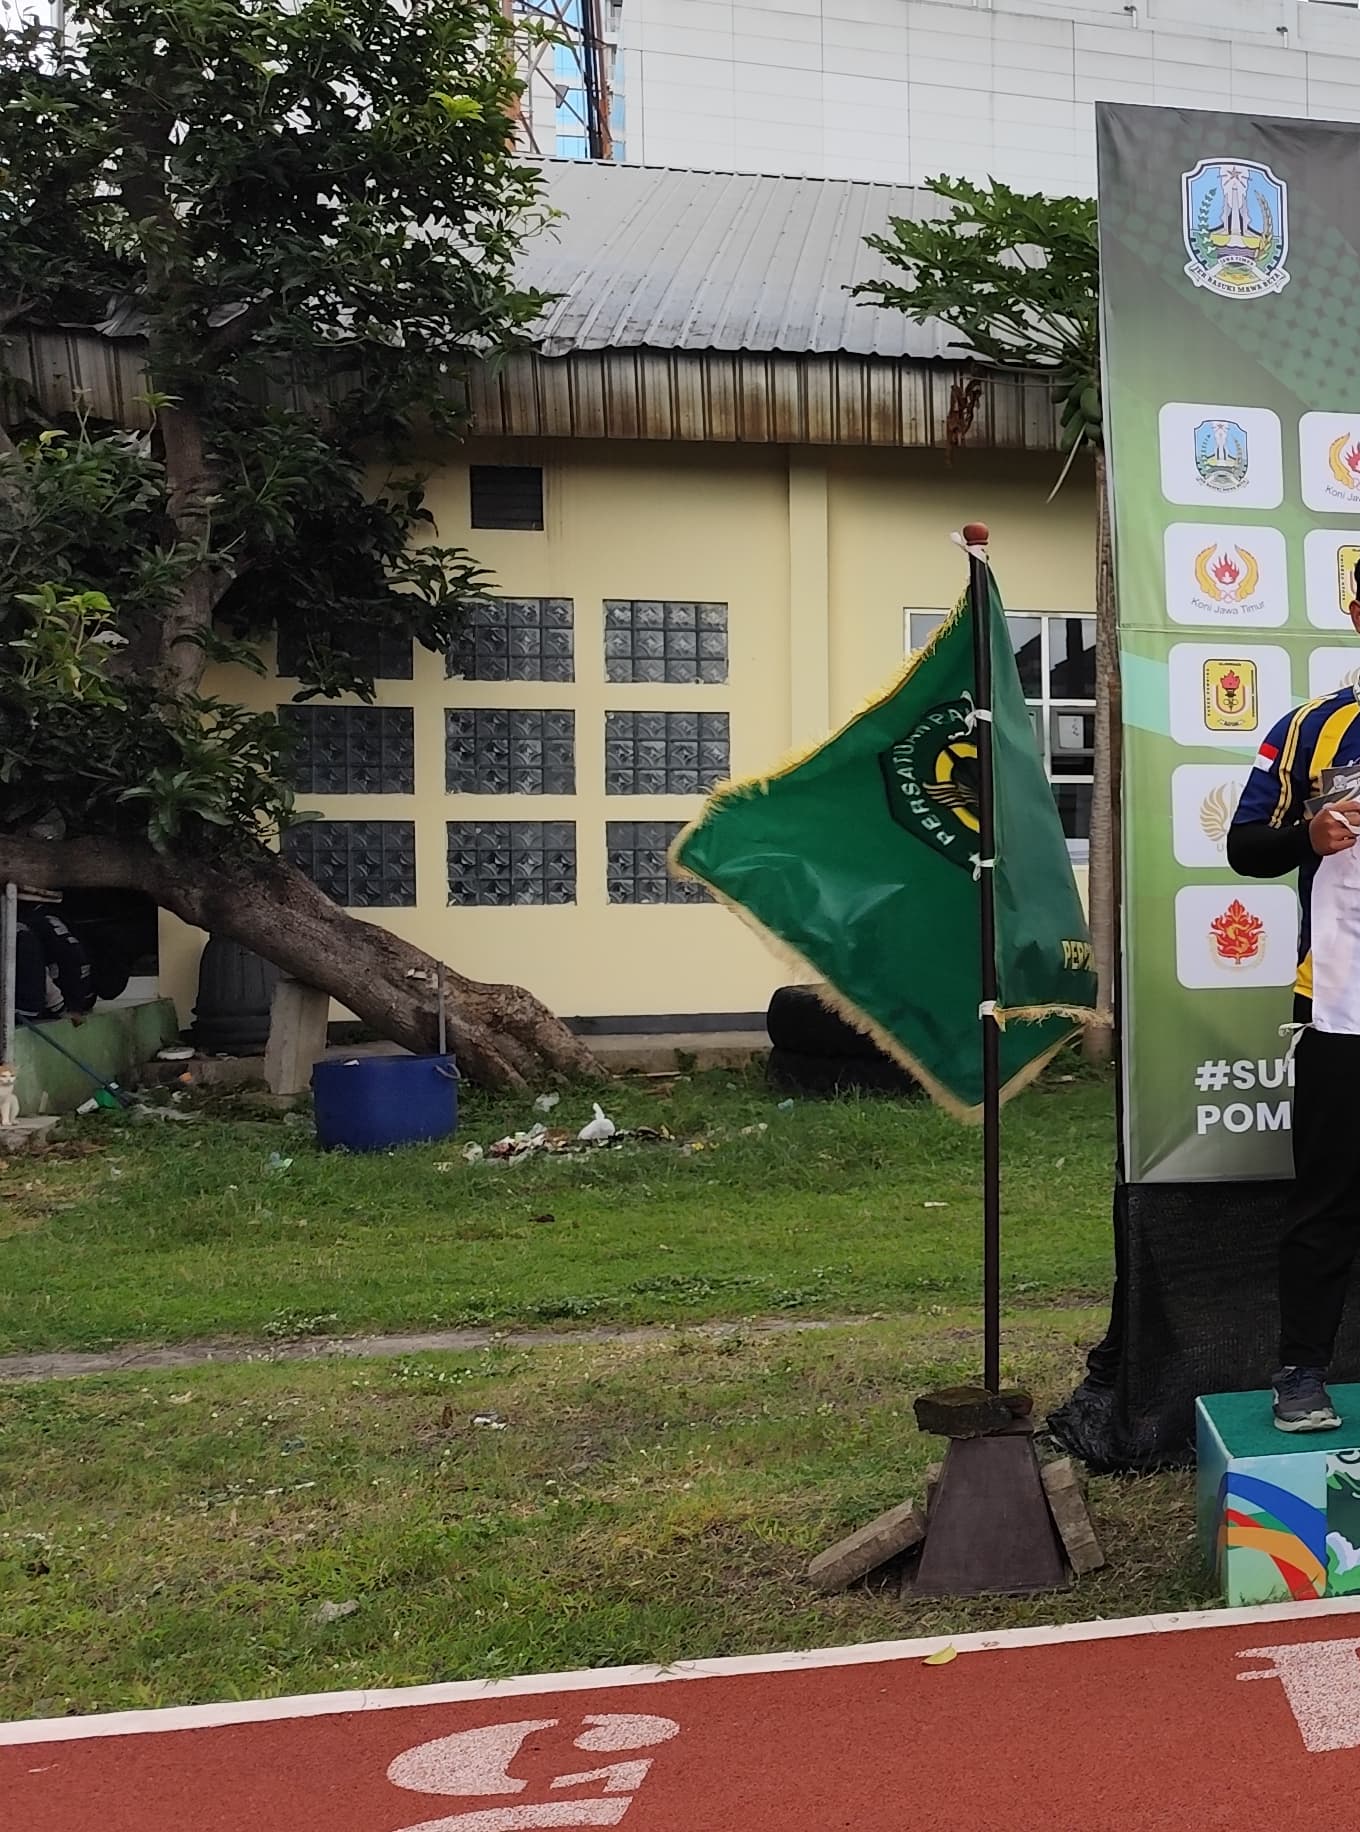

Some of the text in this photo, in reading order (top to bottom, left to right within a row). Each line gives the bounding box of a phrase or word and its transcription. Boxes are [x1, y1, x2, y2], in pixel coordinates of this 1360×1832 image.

[1192, 266, 1206, 280] JER
[1207, 275, 1236, 292] BASUKI
[1237, 284, 1262, 293] MAWA
[1325, 485, 1345, 499] Koni
[1191, 597, 1265, 615] Koni Jawa Timur
[1195, 1058, 1296, 1092] #SU
